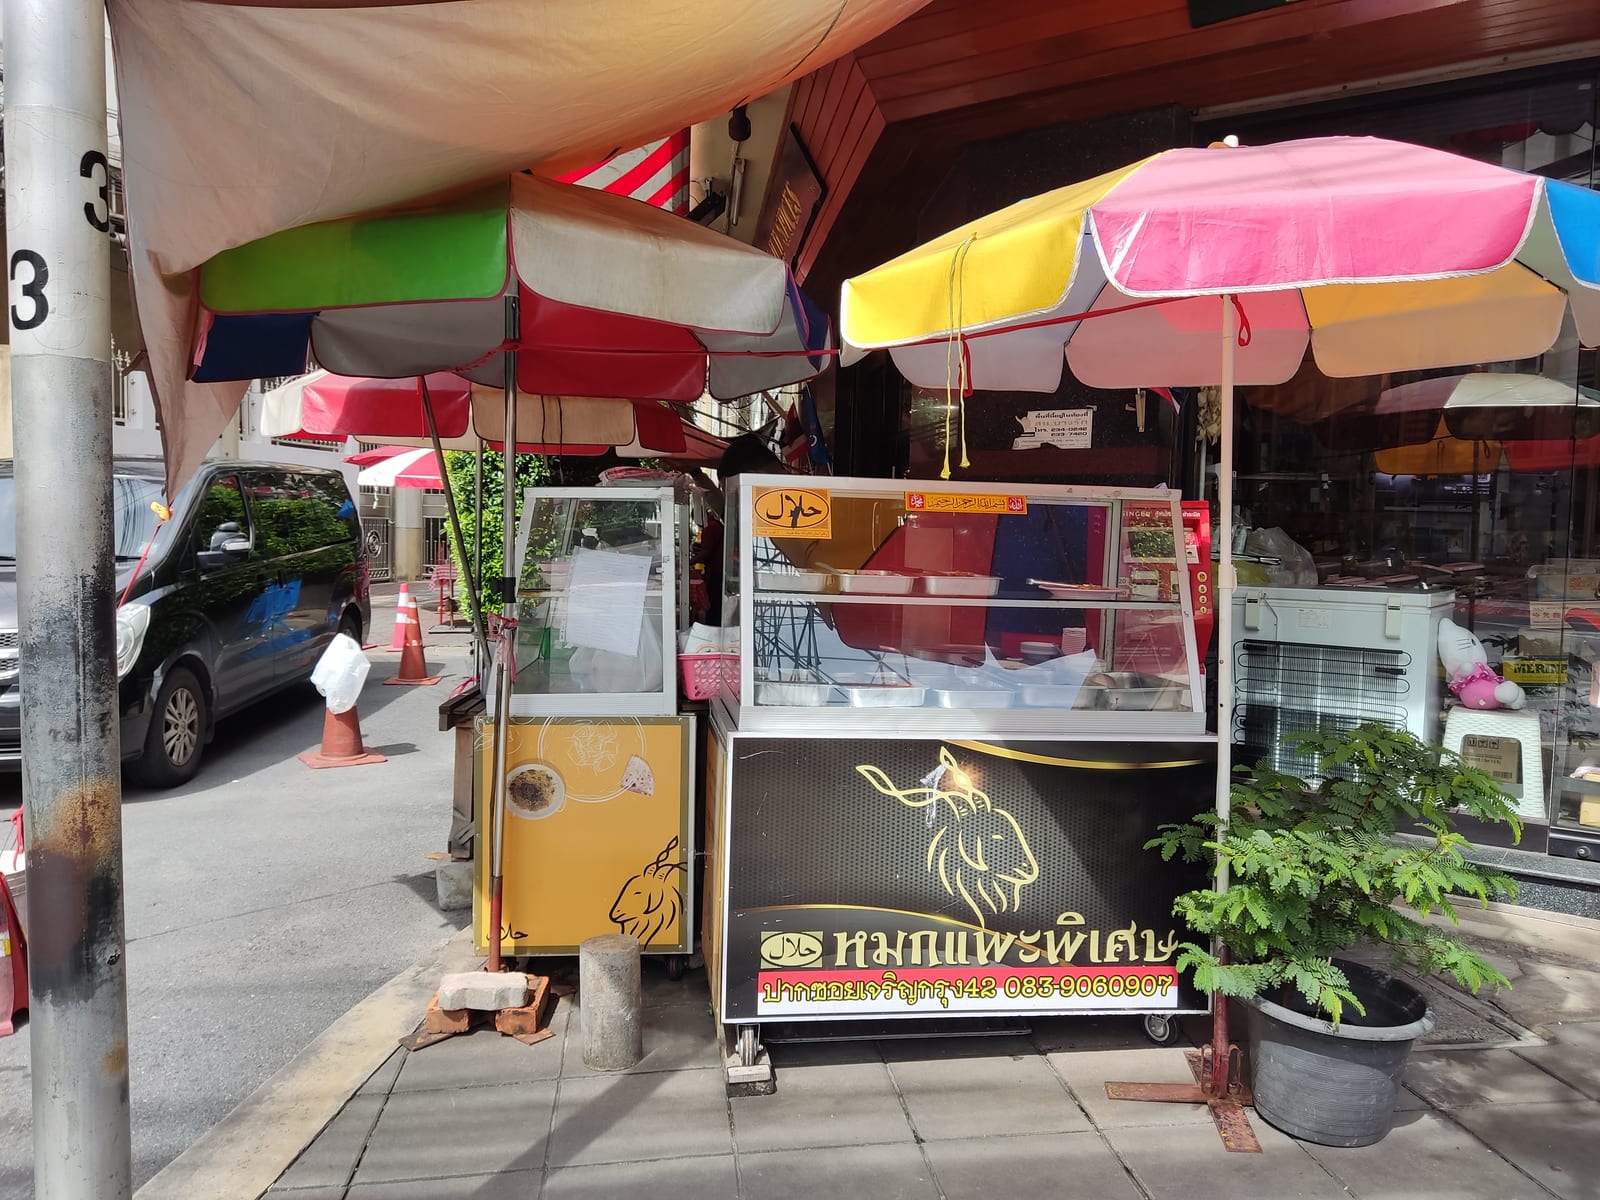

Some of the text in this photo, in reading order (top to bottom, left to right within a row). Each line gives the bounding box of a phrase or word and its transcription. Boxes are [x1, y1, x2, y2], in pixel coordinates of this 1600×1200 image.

[80, 150, 109, 233] 3
[10, 249, 50, 331] 3
[769, 935, 817, 959] حلال
[833, 911, 1179, 967] หมกแพะพิเศษ
[763, 970, 1173, 1008] ปากซอยเจริญกรุง42 083-9060907
